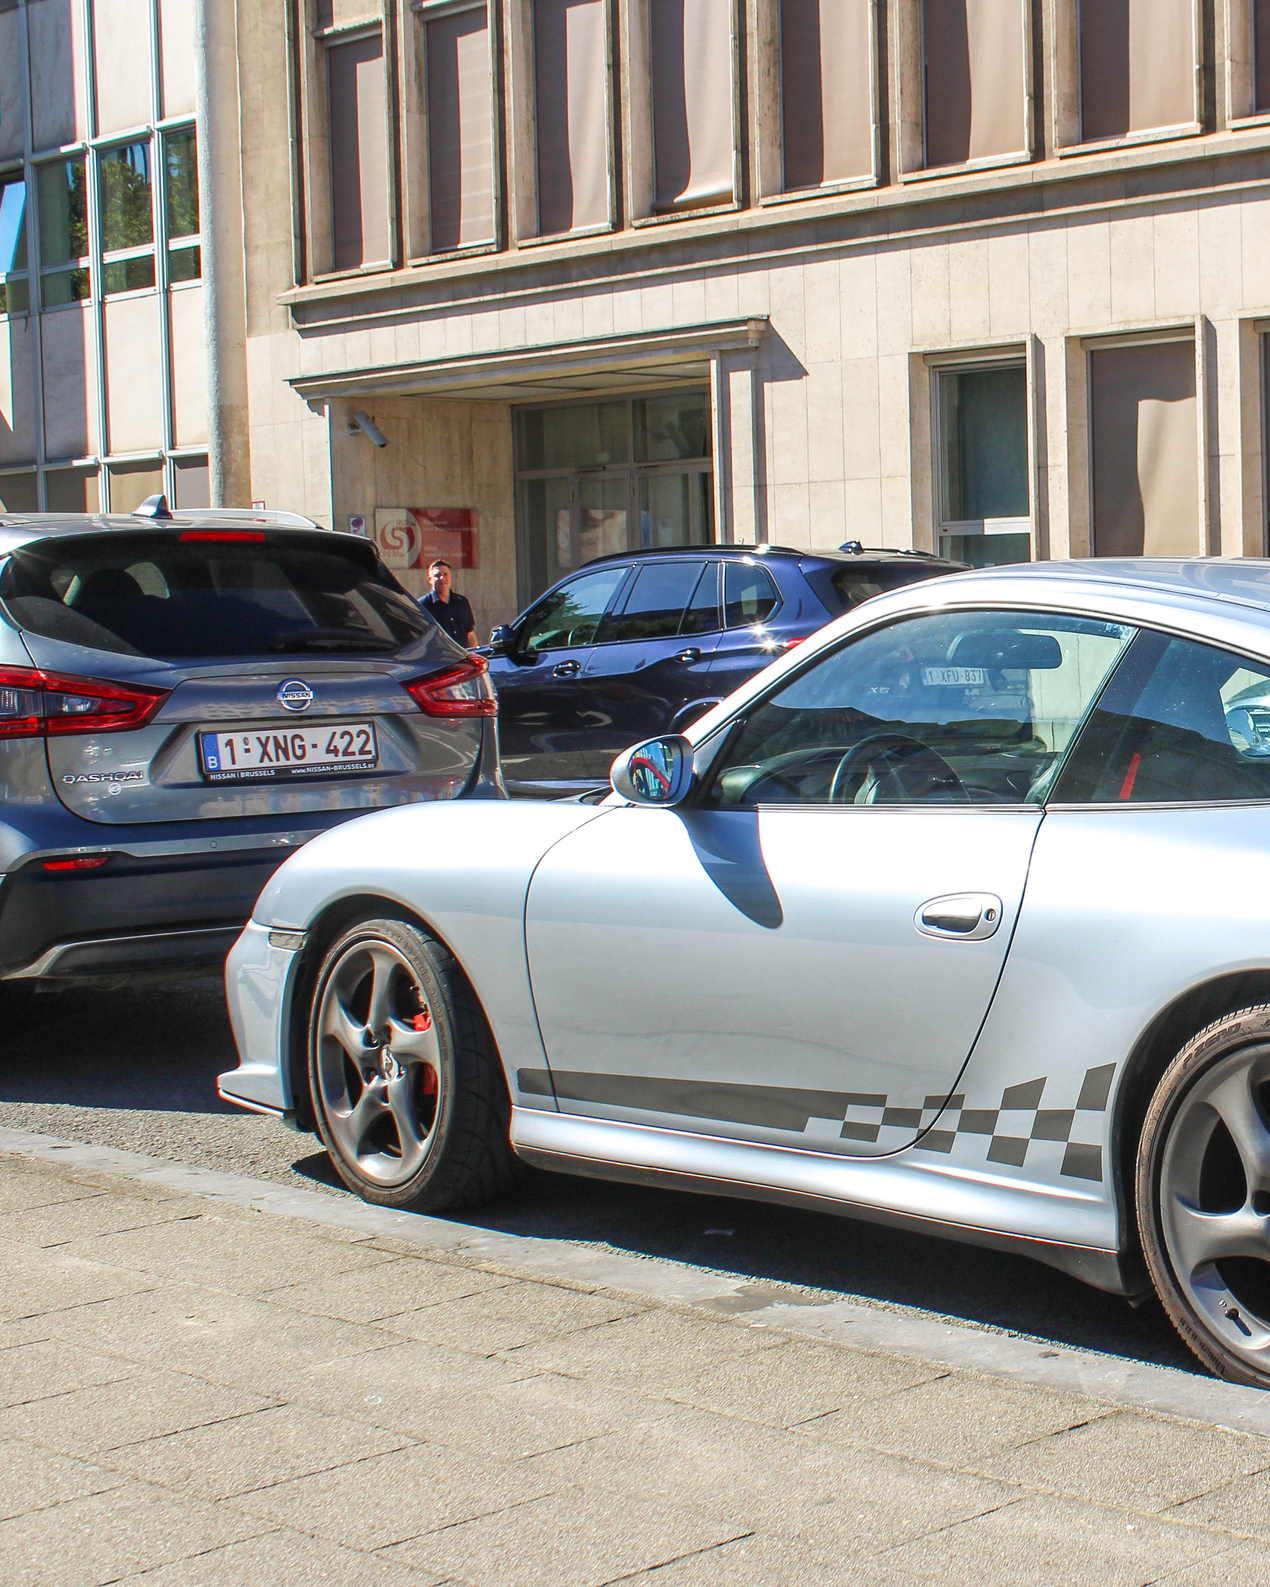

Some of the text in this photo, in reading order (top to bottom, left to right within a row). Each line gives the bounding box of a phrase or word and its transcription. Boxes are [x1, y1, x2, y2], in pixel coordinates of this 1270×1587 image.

[282, 691, 311, 699] NISSAN
[207, 755, 218, 769] B
[62, 771, 145, 784] QASHQAI
[210, 769, 275, 780] NISSAN BRUSSELS
